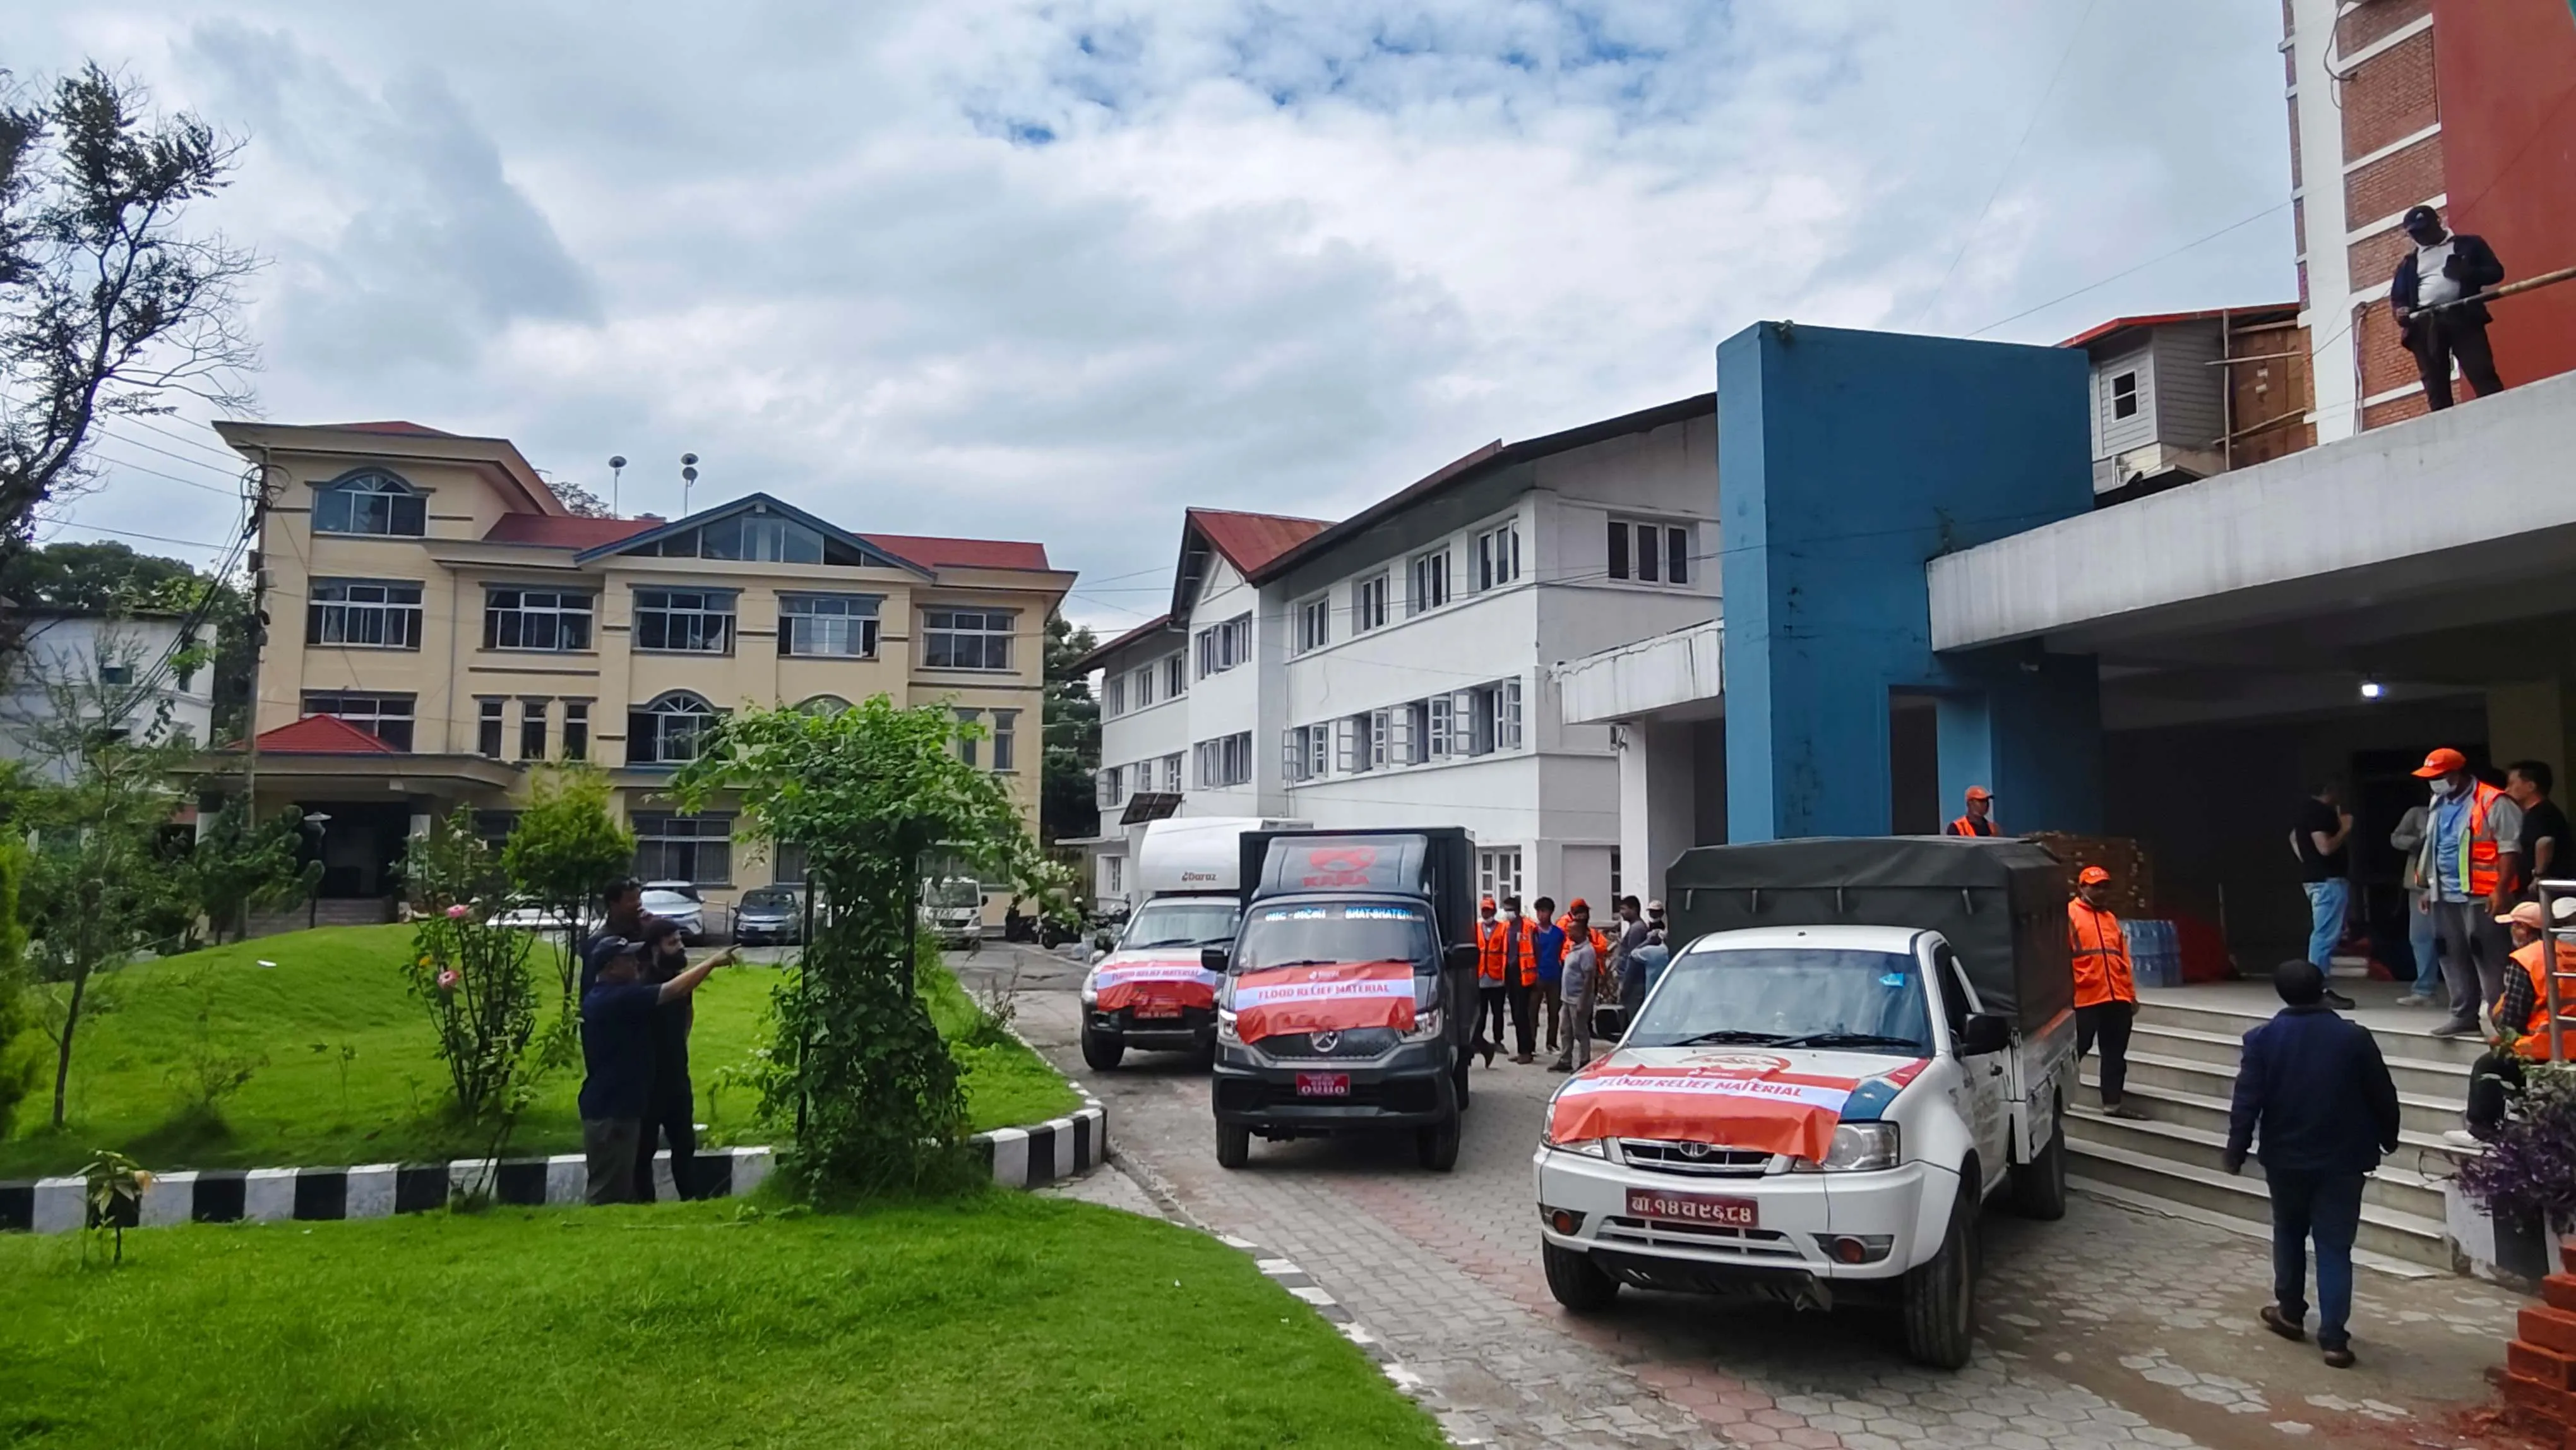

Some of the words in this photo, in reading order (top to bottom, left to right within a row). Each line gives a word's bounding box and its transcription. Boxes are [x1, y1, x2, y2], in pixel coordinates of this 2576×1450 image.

[1188, 872, 1217, 881] Daraz
[1258, 989, 1294, 1000] FLOOD
[1296, 986, 1333, 997] RELIEF
[1335, 983, 1390, 995] MATERIAL
[1599, 1077, 1654, 1086] FLOOD
[1654, 1080, 1713, 1089] RELIEF
[1714, 1081, 1802, 1097] MATERIAL
